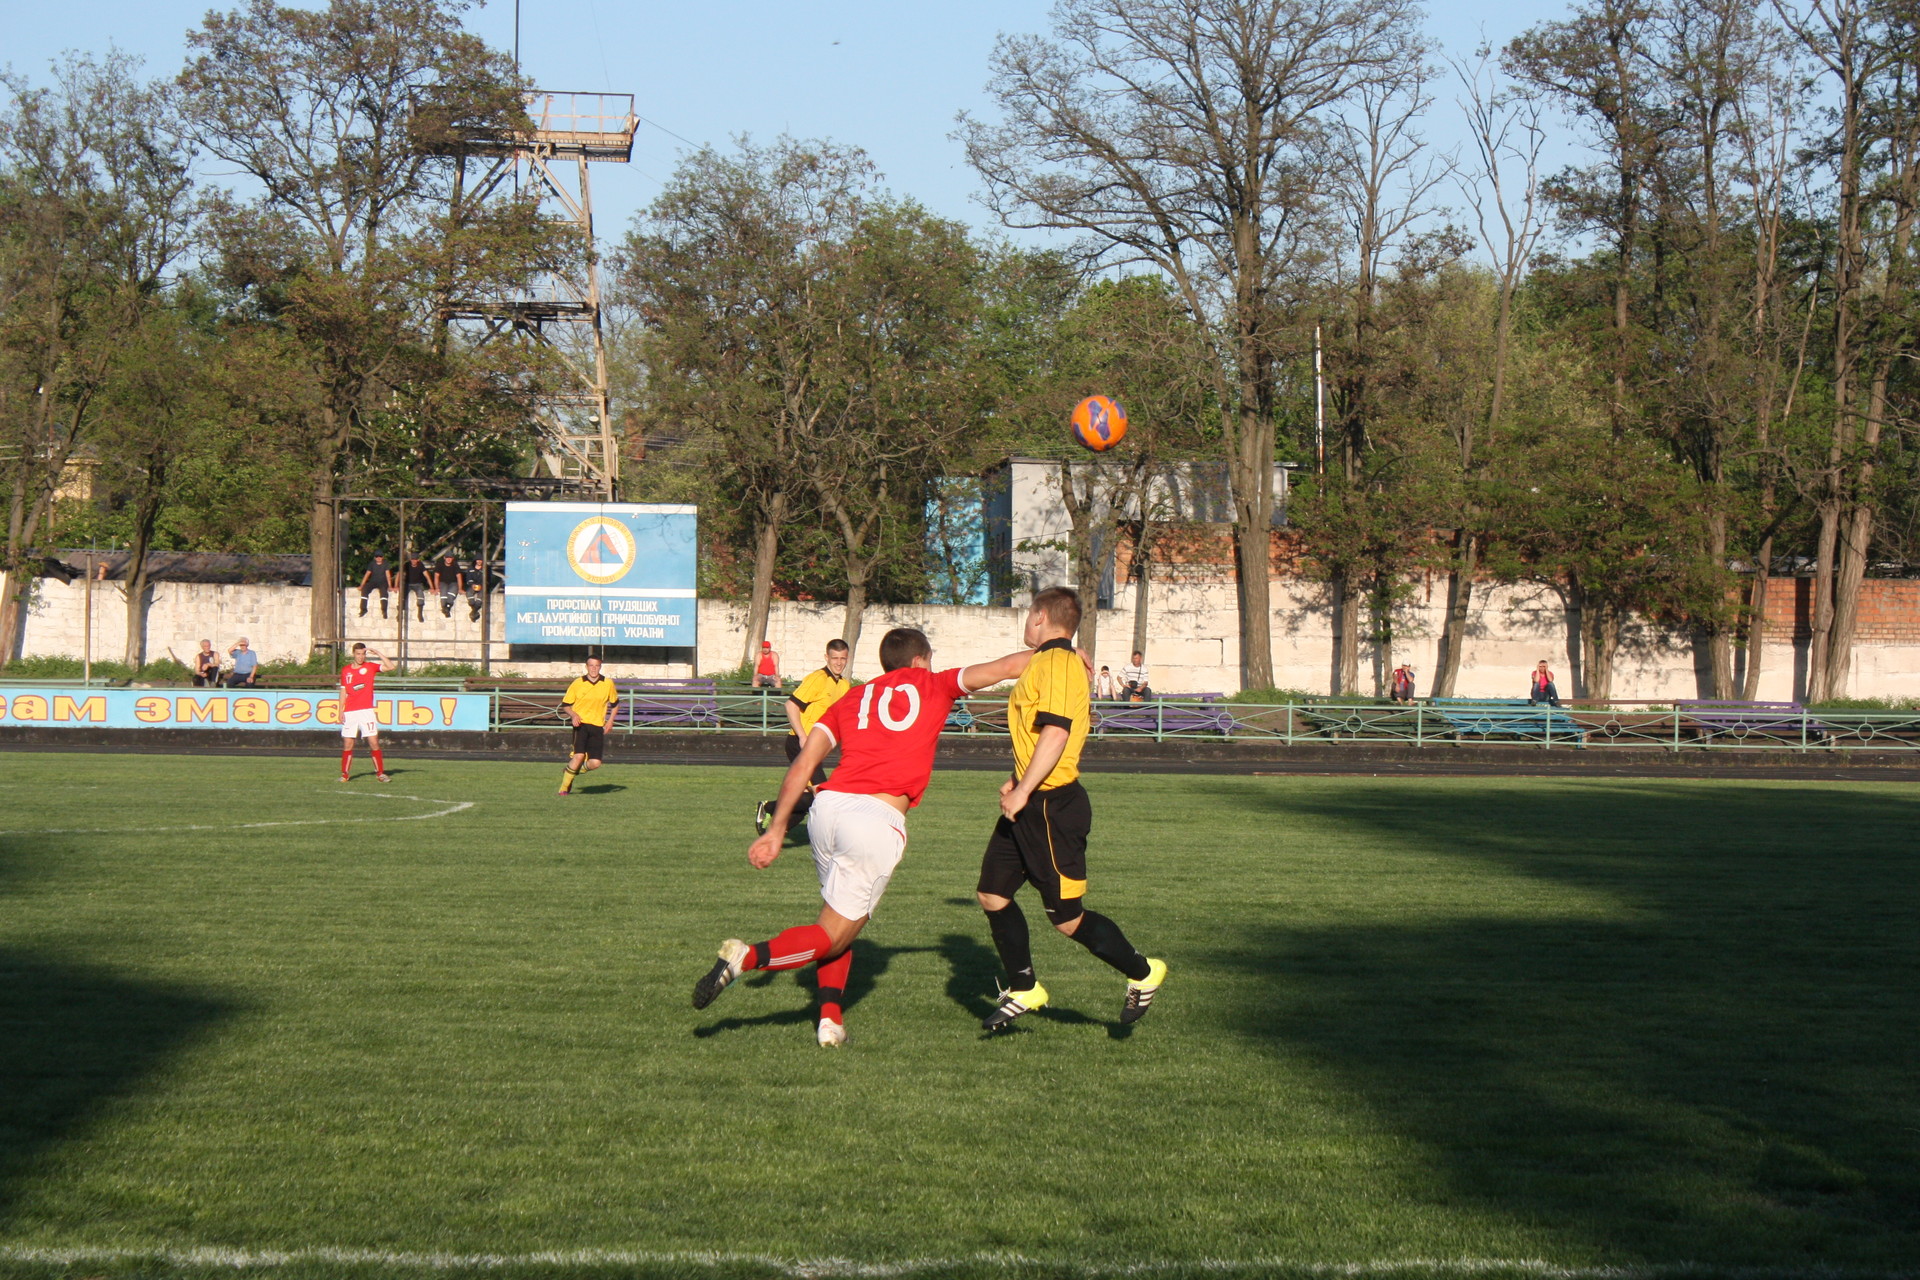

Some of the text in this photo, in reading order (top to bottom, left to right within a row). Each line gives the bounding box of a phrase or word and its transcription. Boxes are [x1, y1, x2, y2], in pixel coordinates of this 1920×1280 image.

[546, 599, 658, 612] ПРОФСПІЛКА ТРУДЯЩИХ
[541, 625, 665, 639] ПРОМИСЛОВОСТІ УКРАЇНИ
[0, 694, 107, 722] ам
[857, 683, 920, 732] 10
[367, 721, 375, 731] 17
